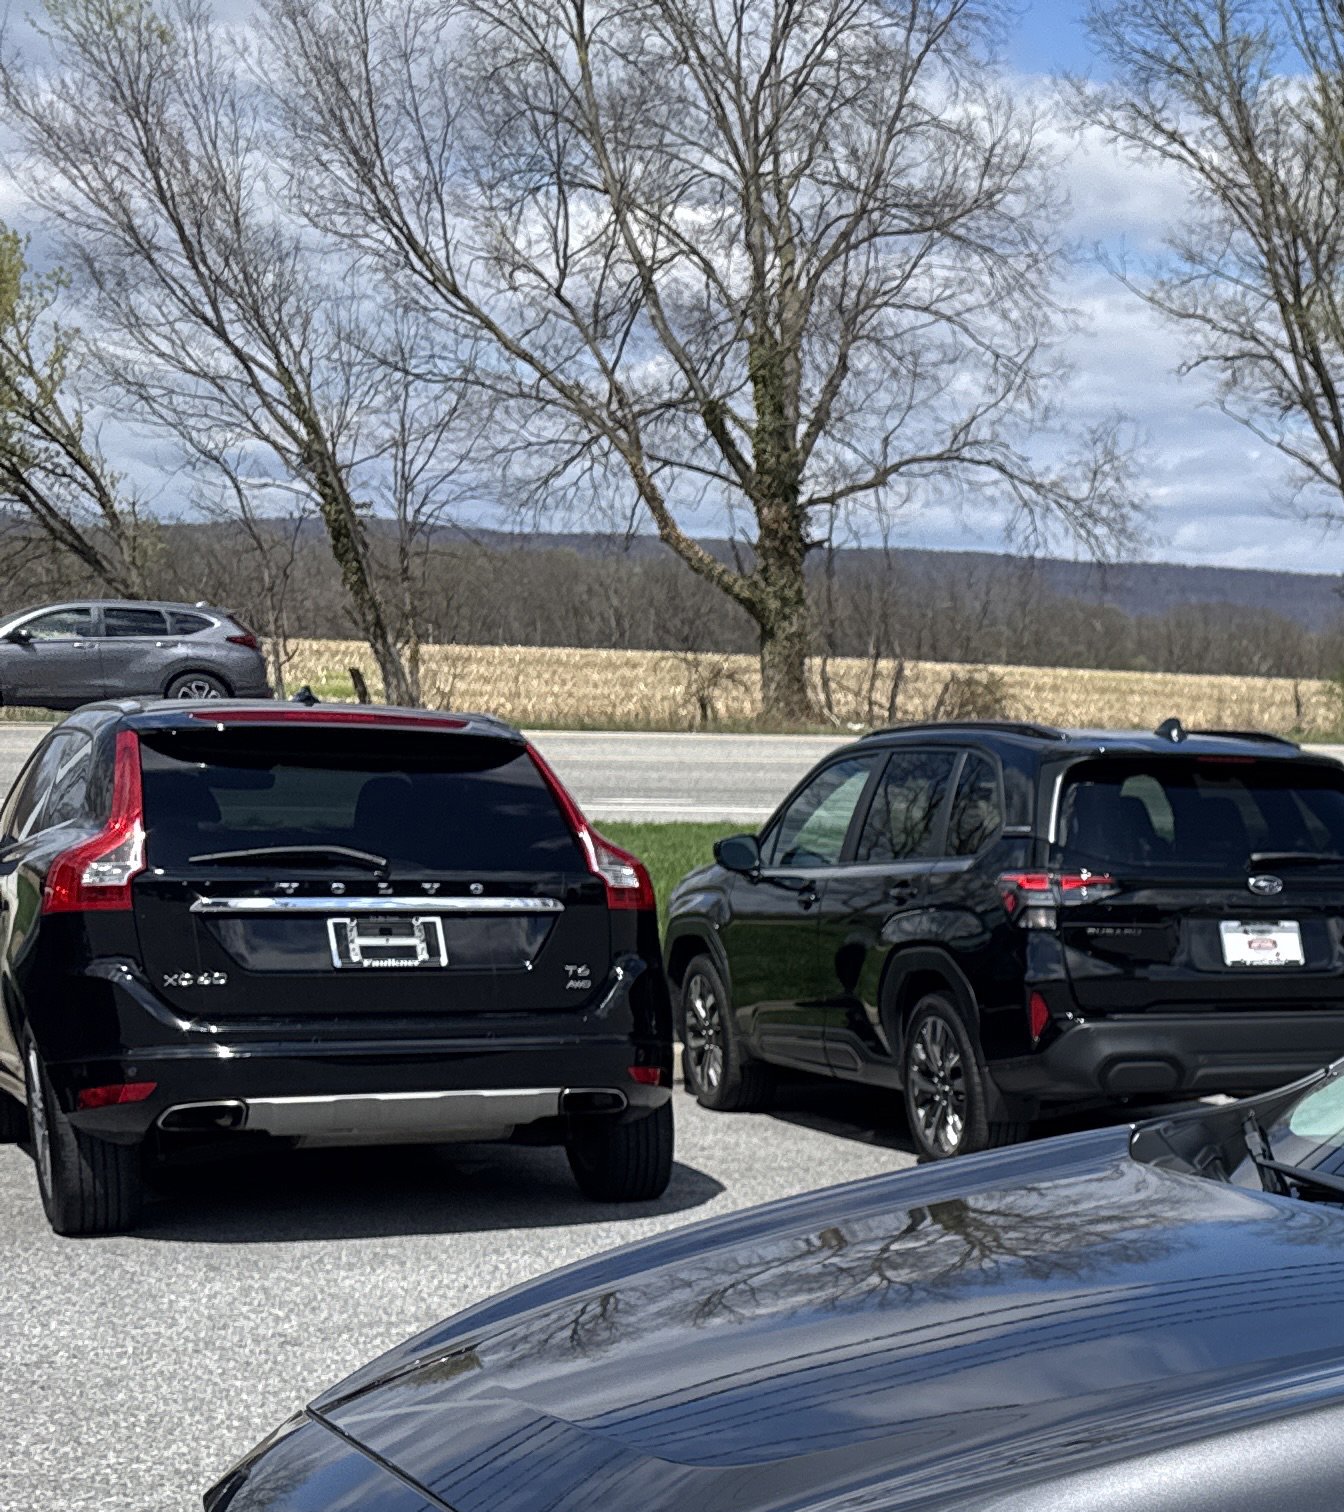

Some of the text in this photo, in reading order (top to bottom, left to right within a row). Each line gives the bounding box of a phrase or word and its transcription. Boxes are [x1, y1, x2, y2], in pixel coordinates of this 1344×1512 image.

[274, 882, 485, 895] VOLVO
[565, 964, 591, 977] T6
[163, 972, 228, 987] XC60
